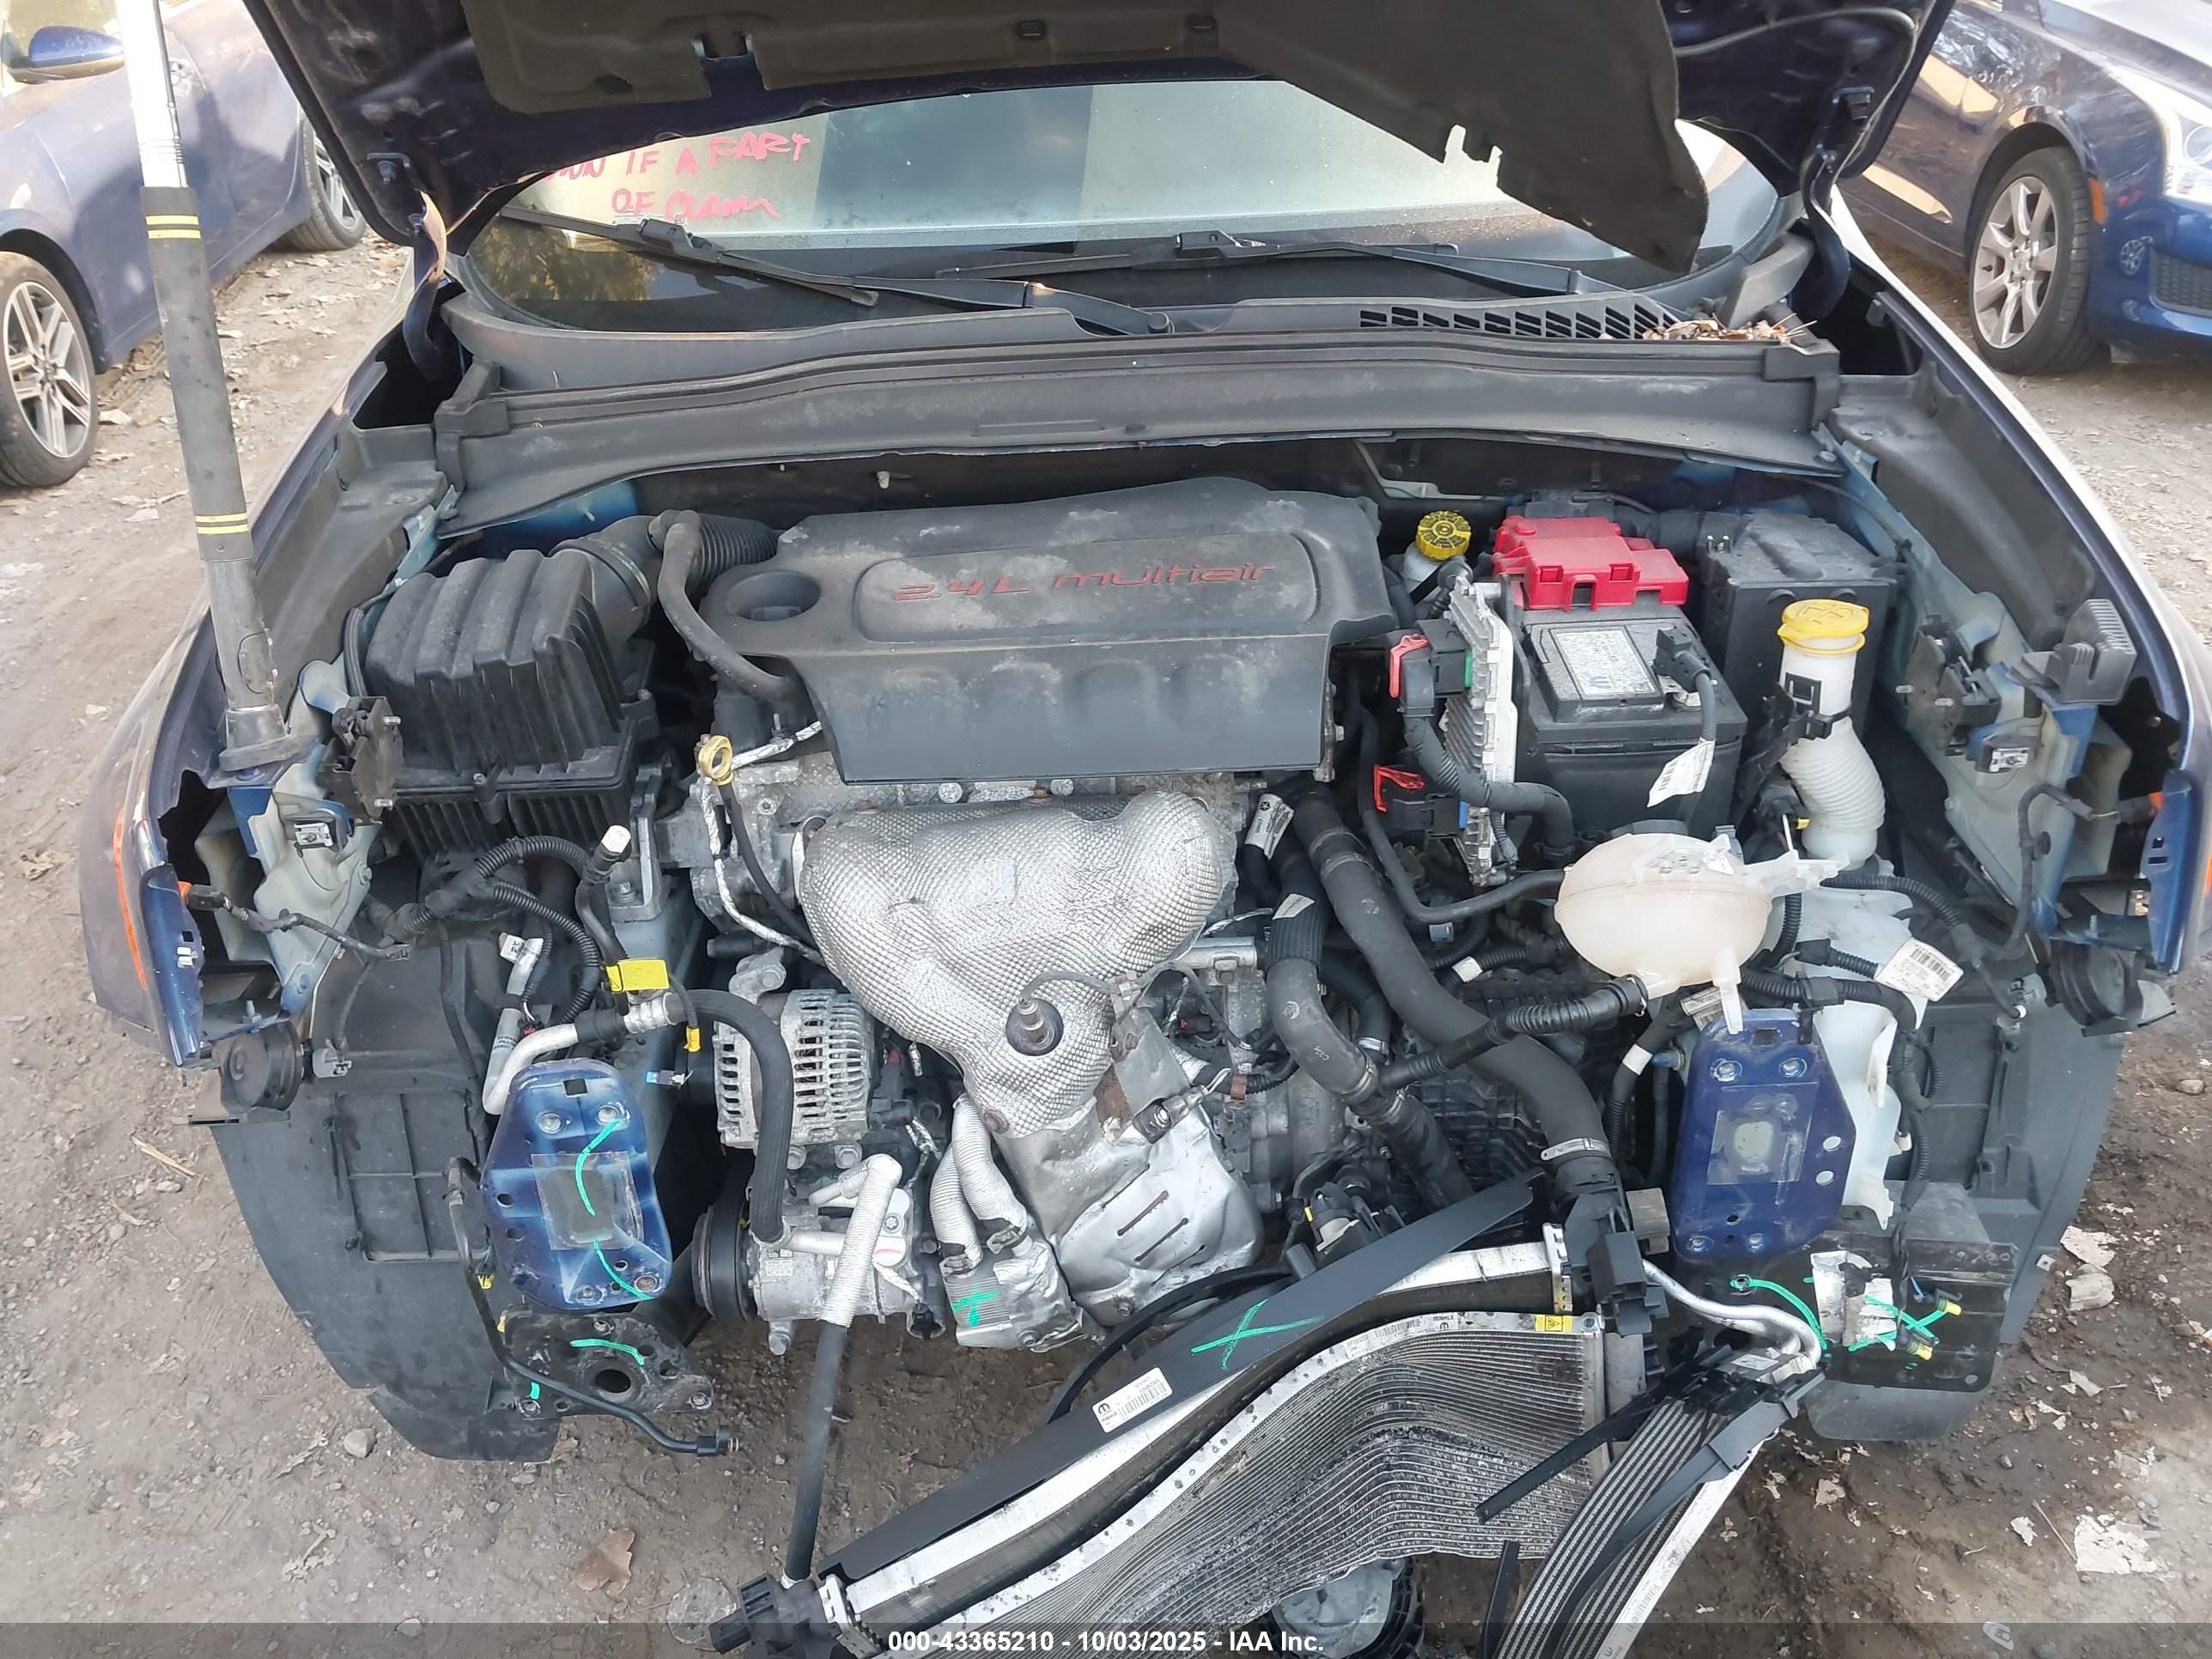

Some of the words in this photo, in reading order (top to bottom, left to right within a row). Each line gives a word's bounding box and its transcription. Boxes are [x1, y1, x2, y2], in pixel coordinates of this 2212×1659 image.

[626, 150, 659, 175] IF
[676, 147, 697, 175] A
[708, 132, 811, 169] PART
[611, 188, 655, 214] OF
[893, 576, 1030, 601] 2.4L
[1053, 562, 1278, 590] multiair
